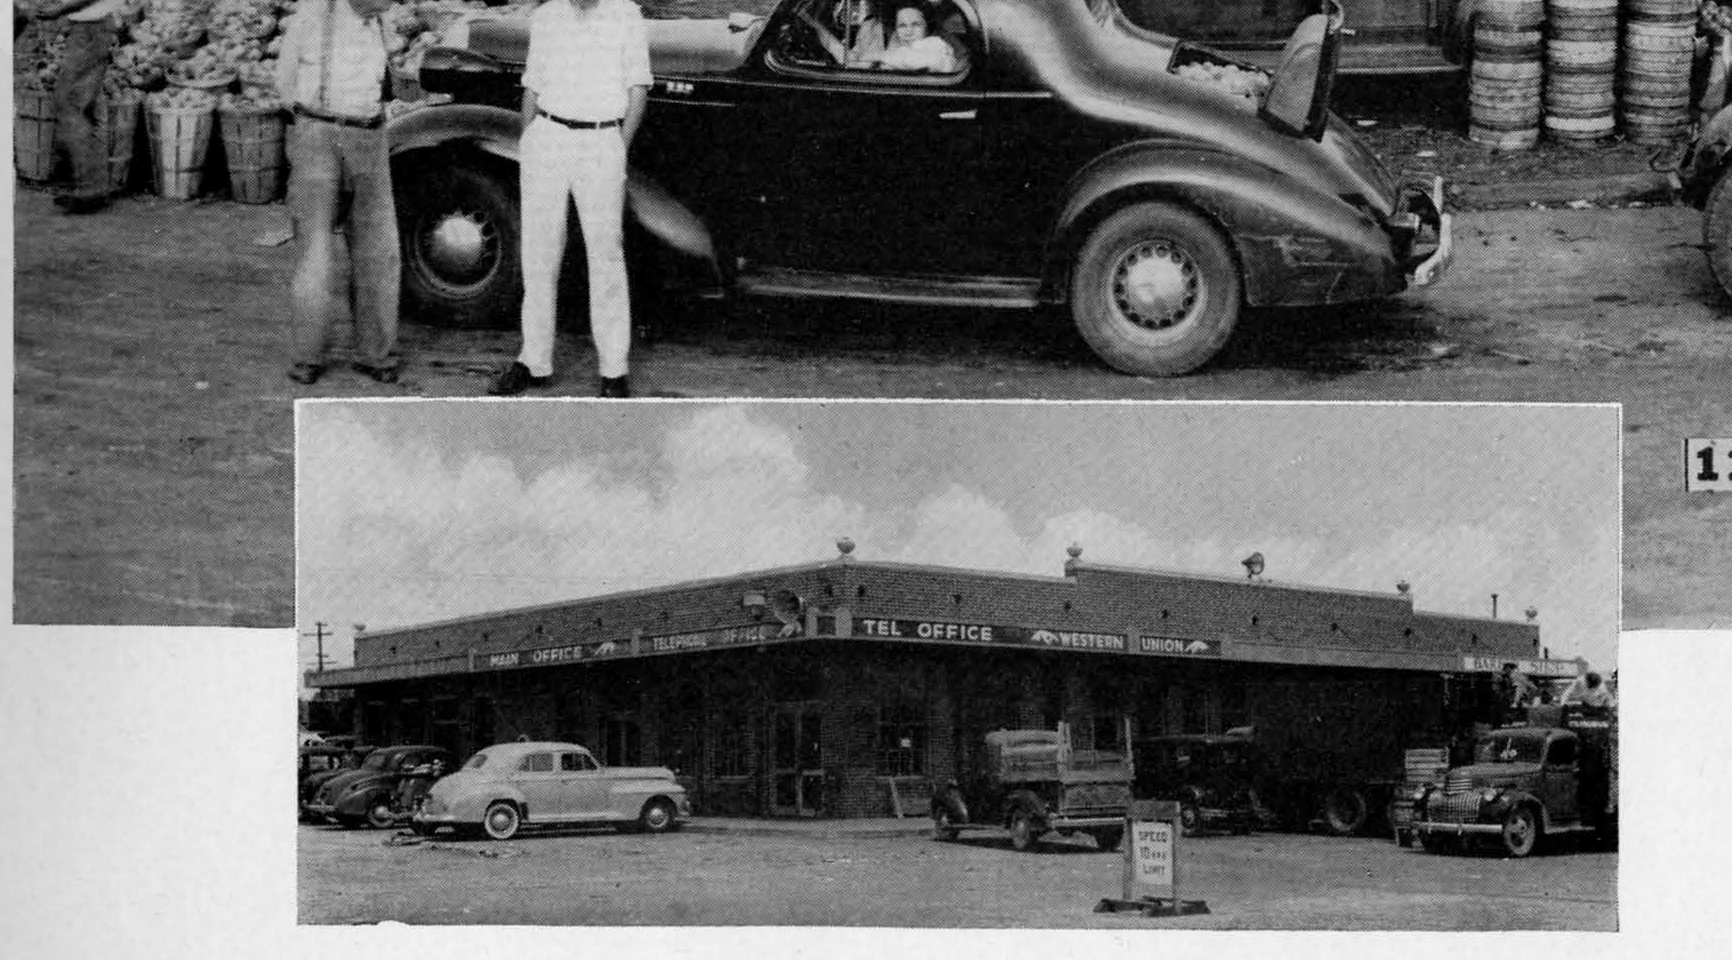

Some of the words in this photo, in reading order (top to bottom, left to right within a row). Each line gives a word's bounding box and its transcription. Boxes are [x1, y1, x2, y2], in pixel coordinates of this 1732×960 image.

[863, 619, 901, 636] TEL
[917, 622, 992, 641] OFFICE
[1058, 632, 1123, 649] WESTERN
[1140, 637, 1184, 652] UNION
[490, 653, 519, 667] MAIN
[533, 646, 582, 663] OFFICE
[1138, 830, 1168, 843] SPEED
